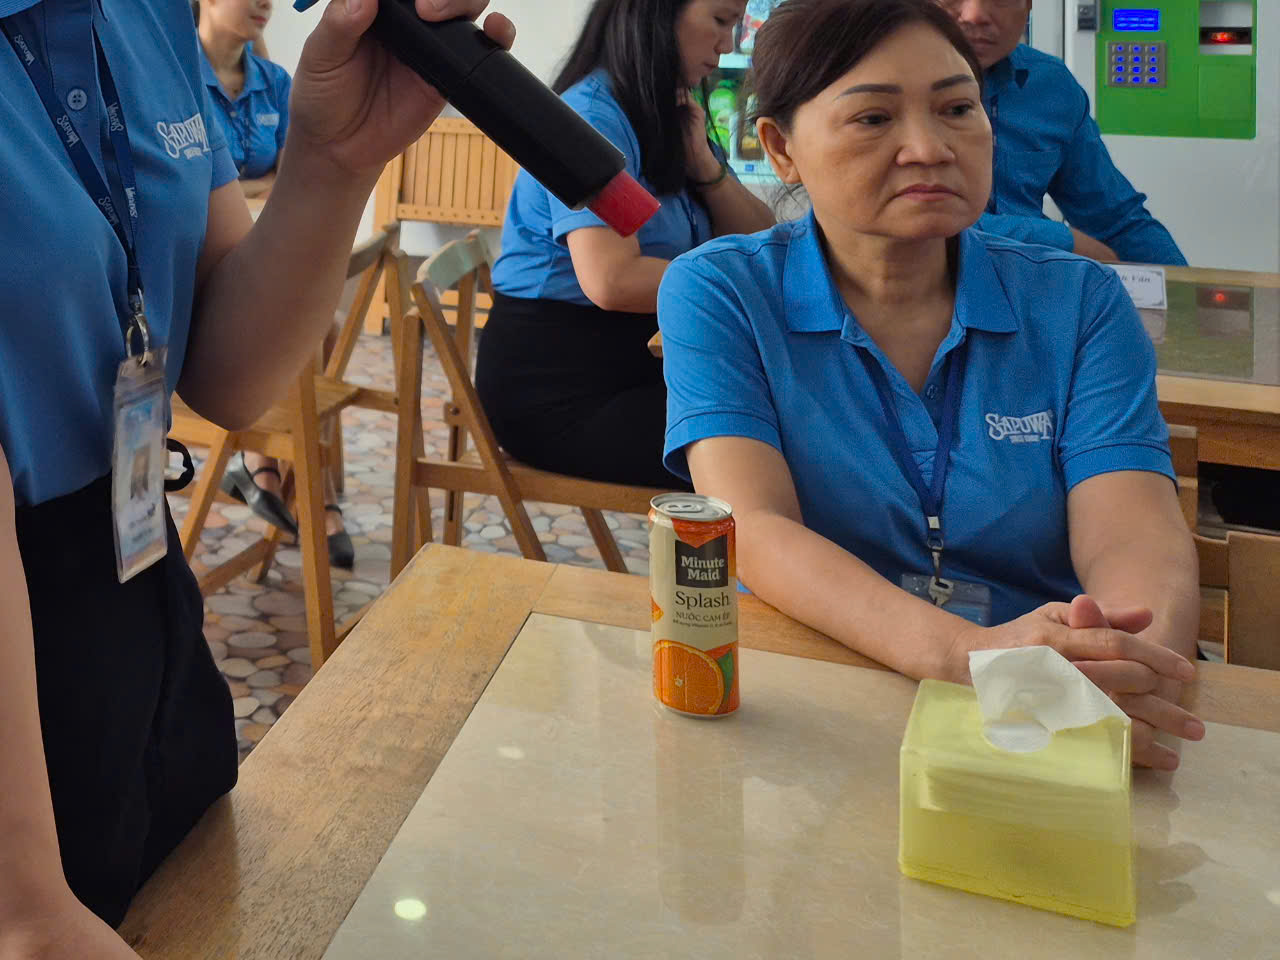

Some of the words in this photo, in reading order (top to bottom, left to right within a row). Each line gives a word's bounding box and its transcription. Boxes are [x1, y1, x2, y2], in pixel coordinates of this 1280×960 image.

[156, 113, 211, 159] SAPUWA
[985, 410, 1054, 441] SAPUWA
[681, 554, 726, 569] Minute
[687, 568, 721, 581] Maid
[675, 591, 732, 611] Splash
[702, 613, 722, 623] CAM
